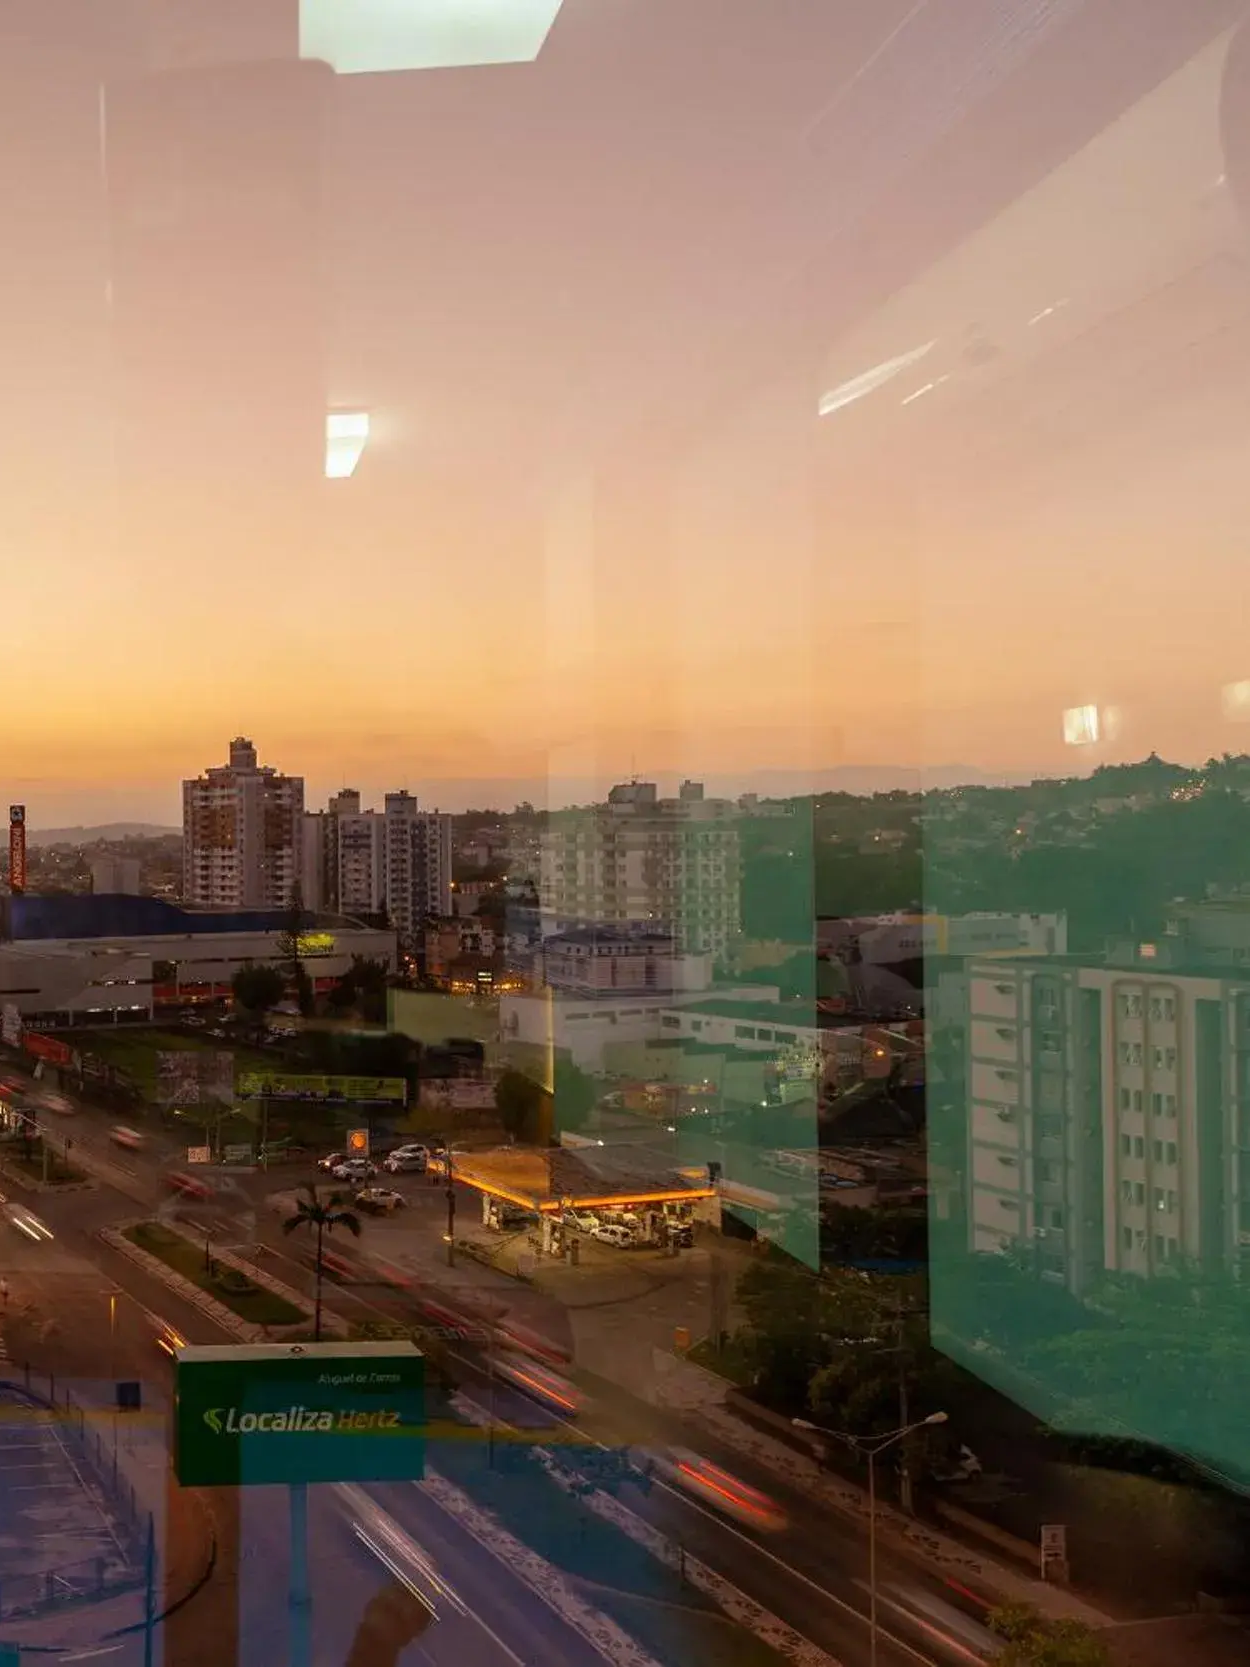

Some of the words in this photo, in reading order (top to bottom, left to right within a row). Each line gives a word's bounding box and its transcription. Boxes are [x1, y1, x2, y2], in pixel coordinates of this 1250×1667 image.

[12, 827, 23, 886] ANGELONI
[226, 1406, 334, 1433] Localiza
[338, 1410, 401, 1429] Hertz
